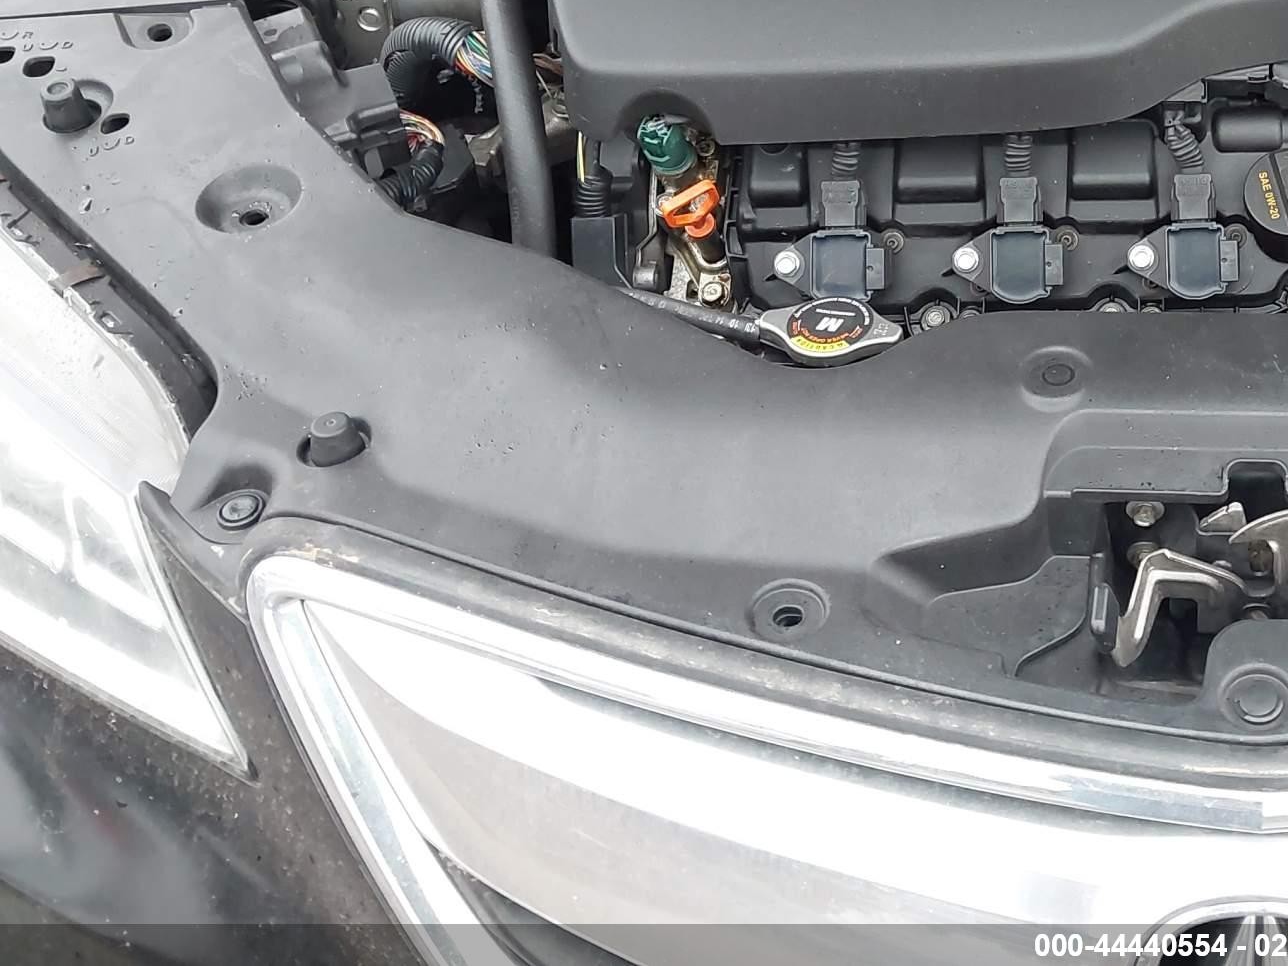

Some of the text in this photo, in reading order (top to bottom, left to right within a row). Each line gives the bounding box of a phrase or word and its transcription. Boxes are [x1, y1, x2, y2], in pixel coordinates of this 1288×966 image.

[1258, 171, 1280, 220] SAE 0W-20
[796, 338, 836, 351] CAUTION
